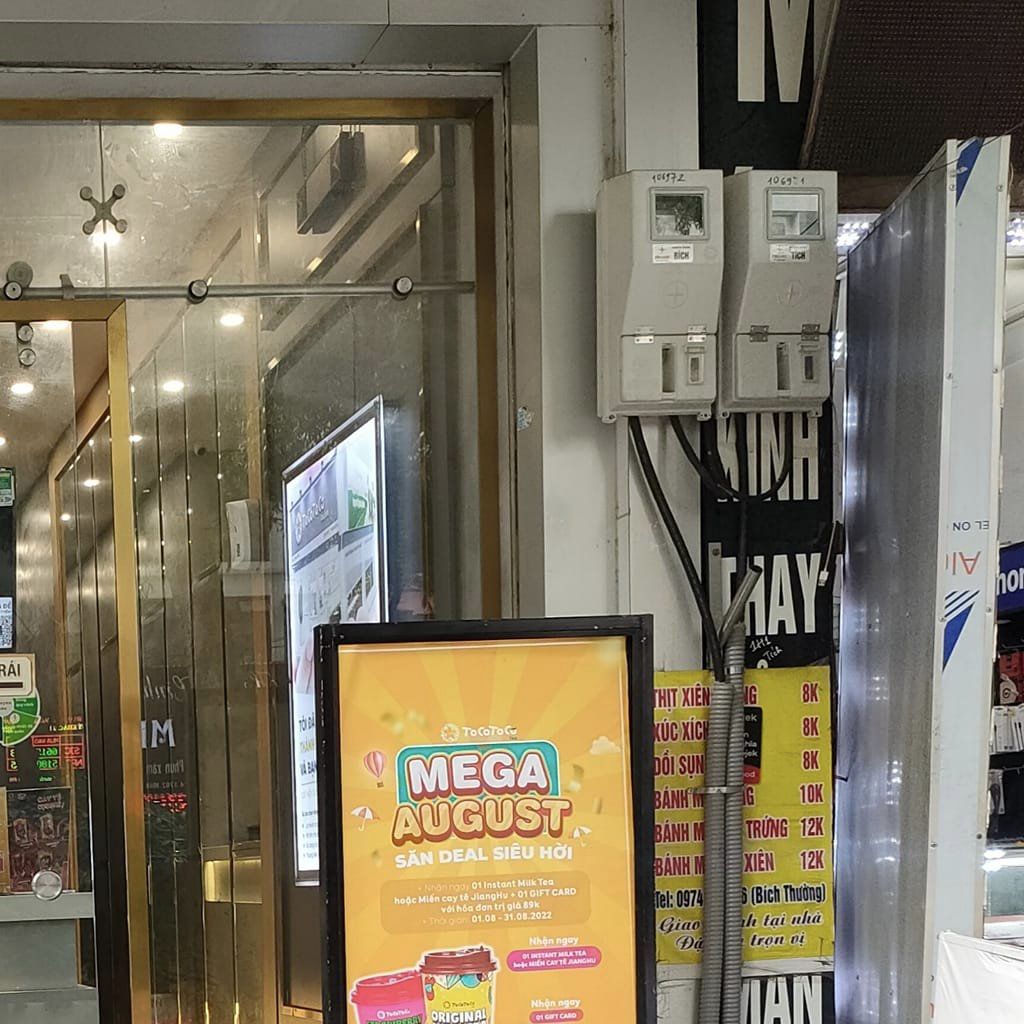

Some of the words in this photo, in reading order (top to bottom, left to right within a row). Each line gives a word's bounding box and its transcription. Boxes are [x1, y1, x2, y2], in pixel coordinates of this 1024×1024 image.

[802, 682, 819, 704] 8K
[802, 716, 819, 737] 8K
[802, 750, 819, 770] 8K
[407, 751, 550, 801] MEGA
[654, 786, 689, 810] BÁNH
[800, 783, 823, 804] 10K
[392, 798, 573, 847] AUGUST
[654, 819, 690, 843] BÁNH
[745, 816, 789, 839] TRỨNG
[800, 816, 824, 837] 12K
[395, 850, 434, 869] SĂN
[438, 848, 489, 865] DEAL
[493, 843, 535, 862] SIÊU
[539, 845, 573, 861] HỜI
[655, 853, 691, 877] BÁNH
[743, 849, 775, 872] XIÊN
[800, 850, 824, 870] 12K
[483, 880, 517, 889] Instant
[538, 878, 554, 887] Tea
[551, 887, 577, 896] CARD
[655, 890, 674, 909] Tel:
[660, 917, 701, 934] Giao
[763, 912, 786, 929] tại
[529, 937, 554, 947] Nhận
[555, 936, 579, 946] ngay
[531, 999, 556, 1009] Nhận
[558, 999, 581, 1008] ngay
[431, 1008, 487, 1024] ORIGINAL
